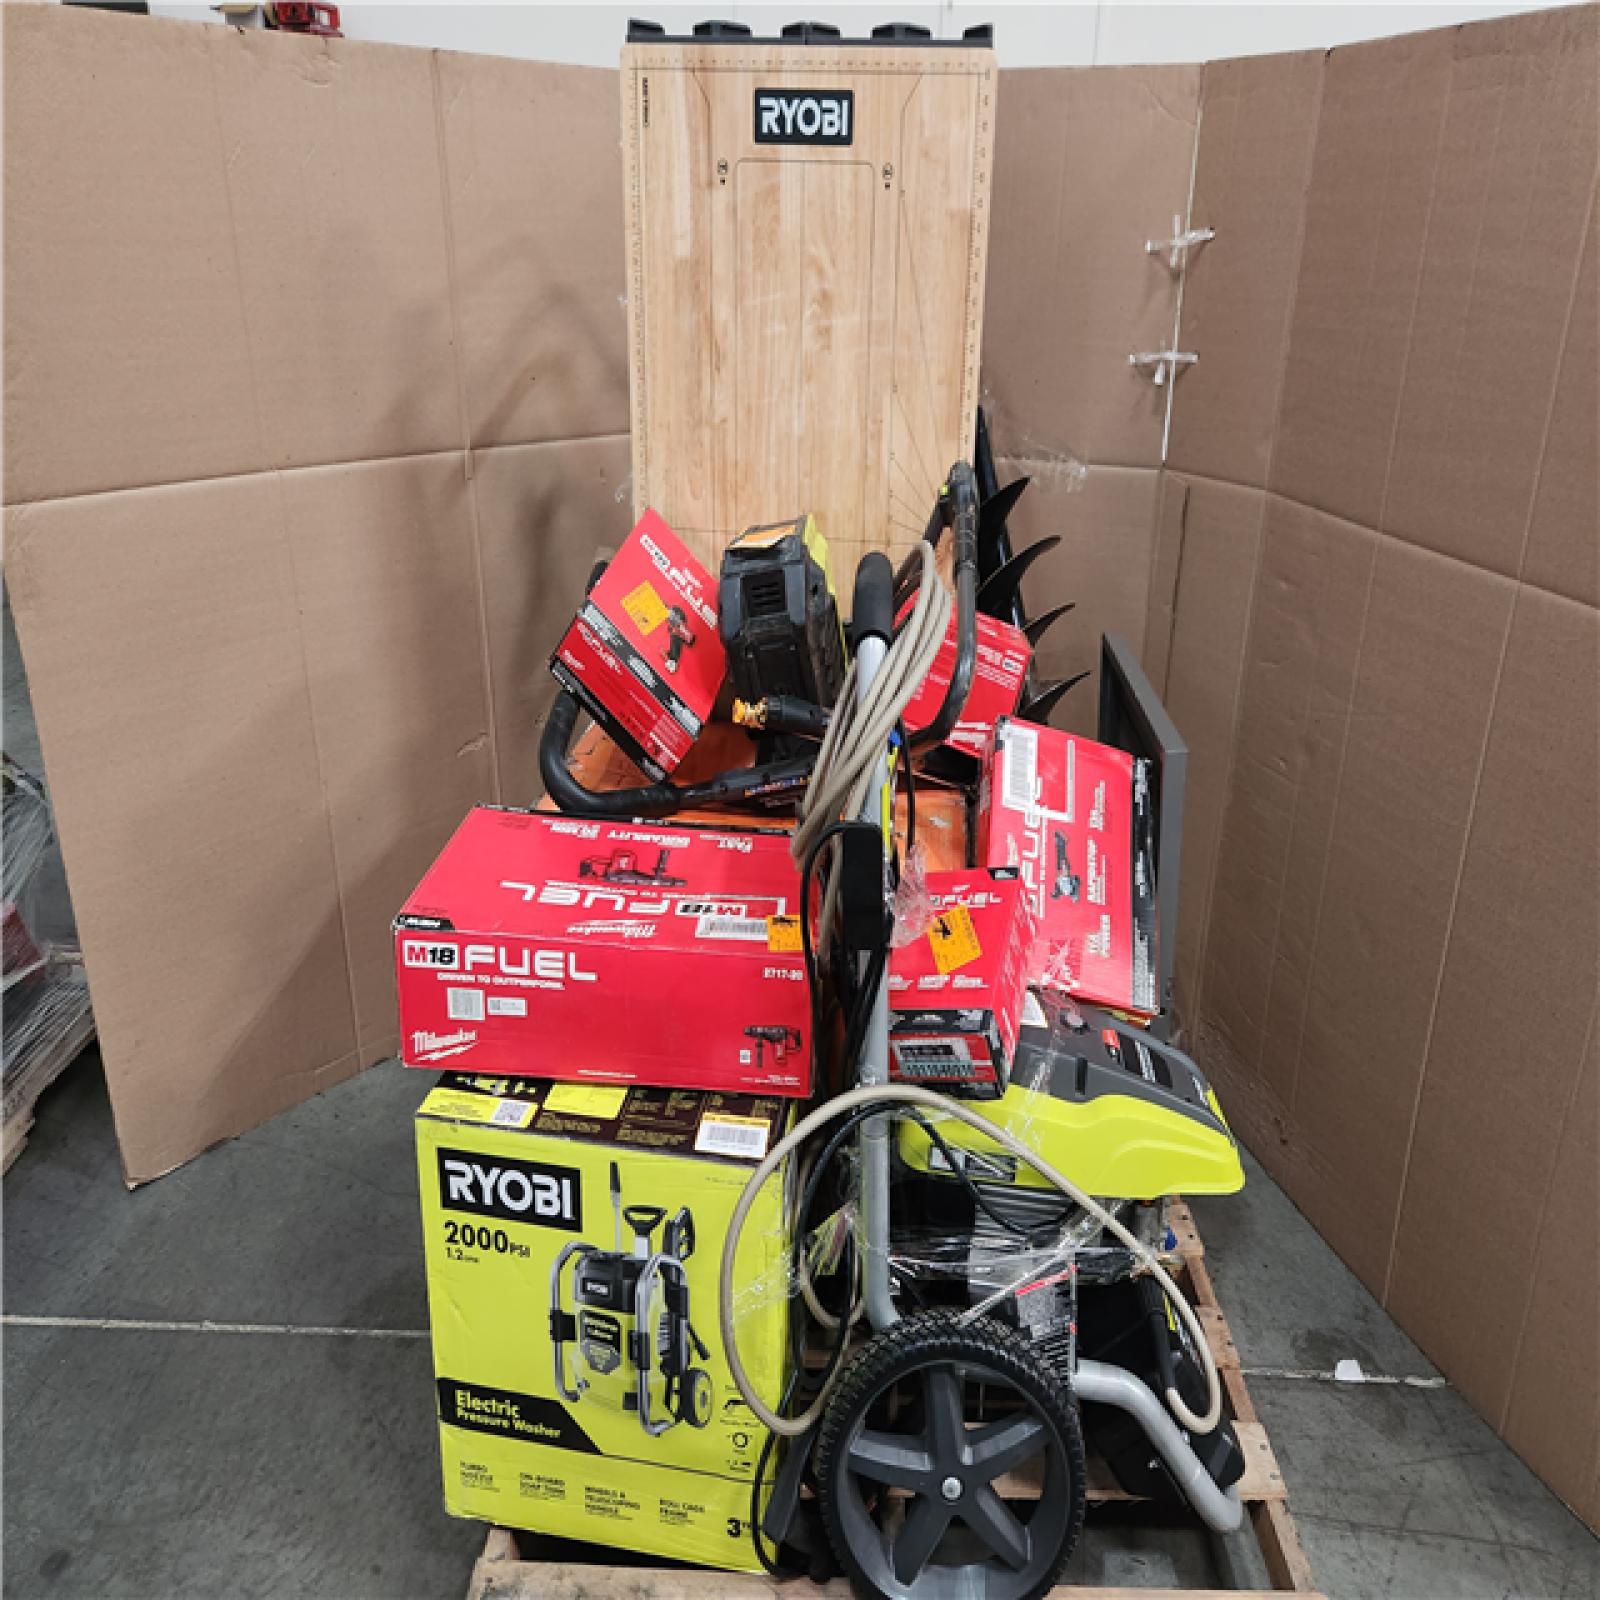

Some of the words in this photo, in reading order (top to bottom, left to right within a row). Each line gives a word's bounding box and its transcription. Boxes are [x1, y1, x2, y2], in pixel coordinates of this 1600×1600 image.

[759, 97, 849, 138] RYOBI
[500, 879, 670, 914] FUEL
[566, 921, 657, 938] Milwaukee
[406, 944, 457, 966] M18
[463, 944, 599, 983] FUEL
[410, 1028, 478, 1055] Milwaukee
[444, 1159, 573, 1220] RYOBI
[444, 1219, 509, 1254] 2000
[455, 1389, 521, 1419] Electric
[456, 1407, 510, 1429] Pressure
[512, 1419, 562, 1439] Washer
[727, 1517, 741, 1538] 3
